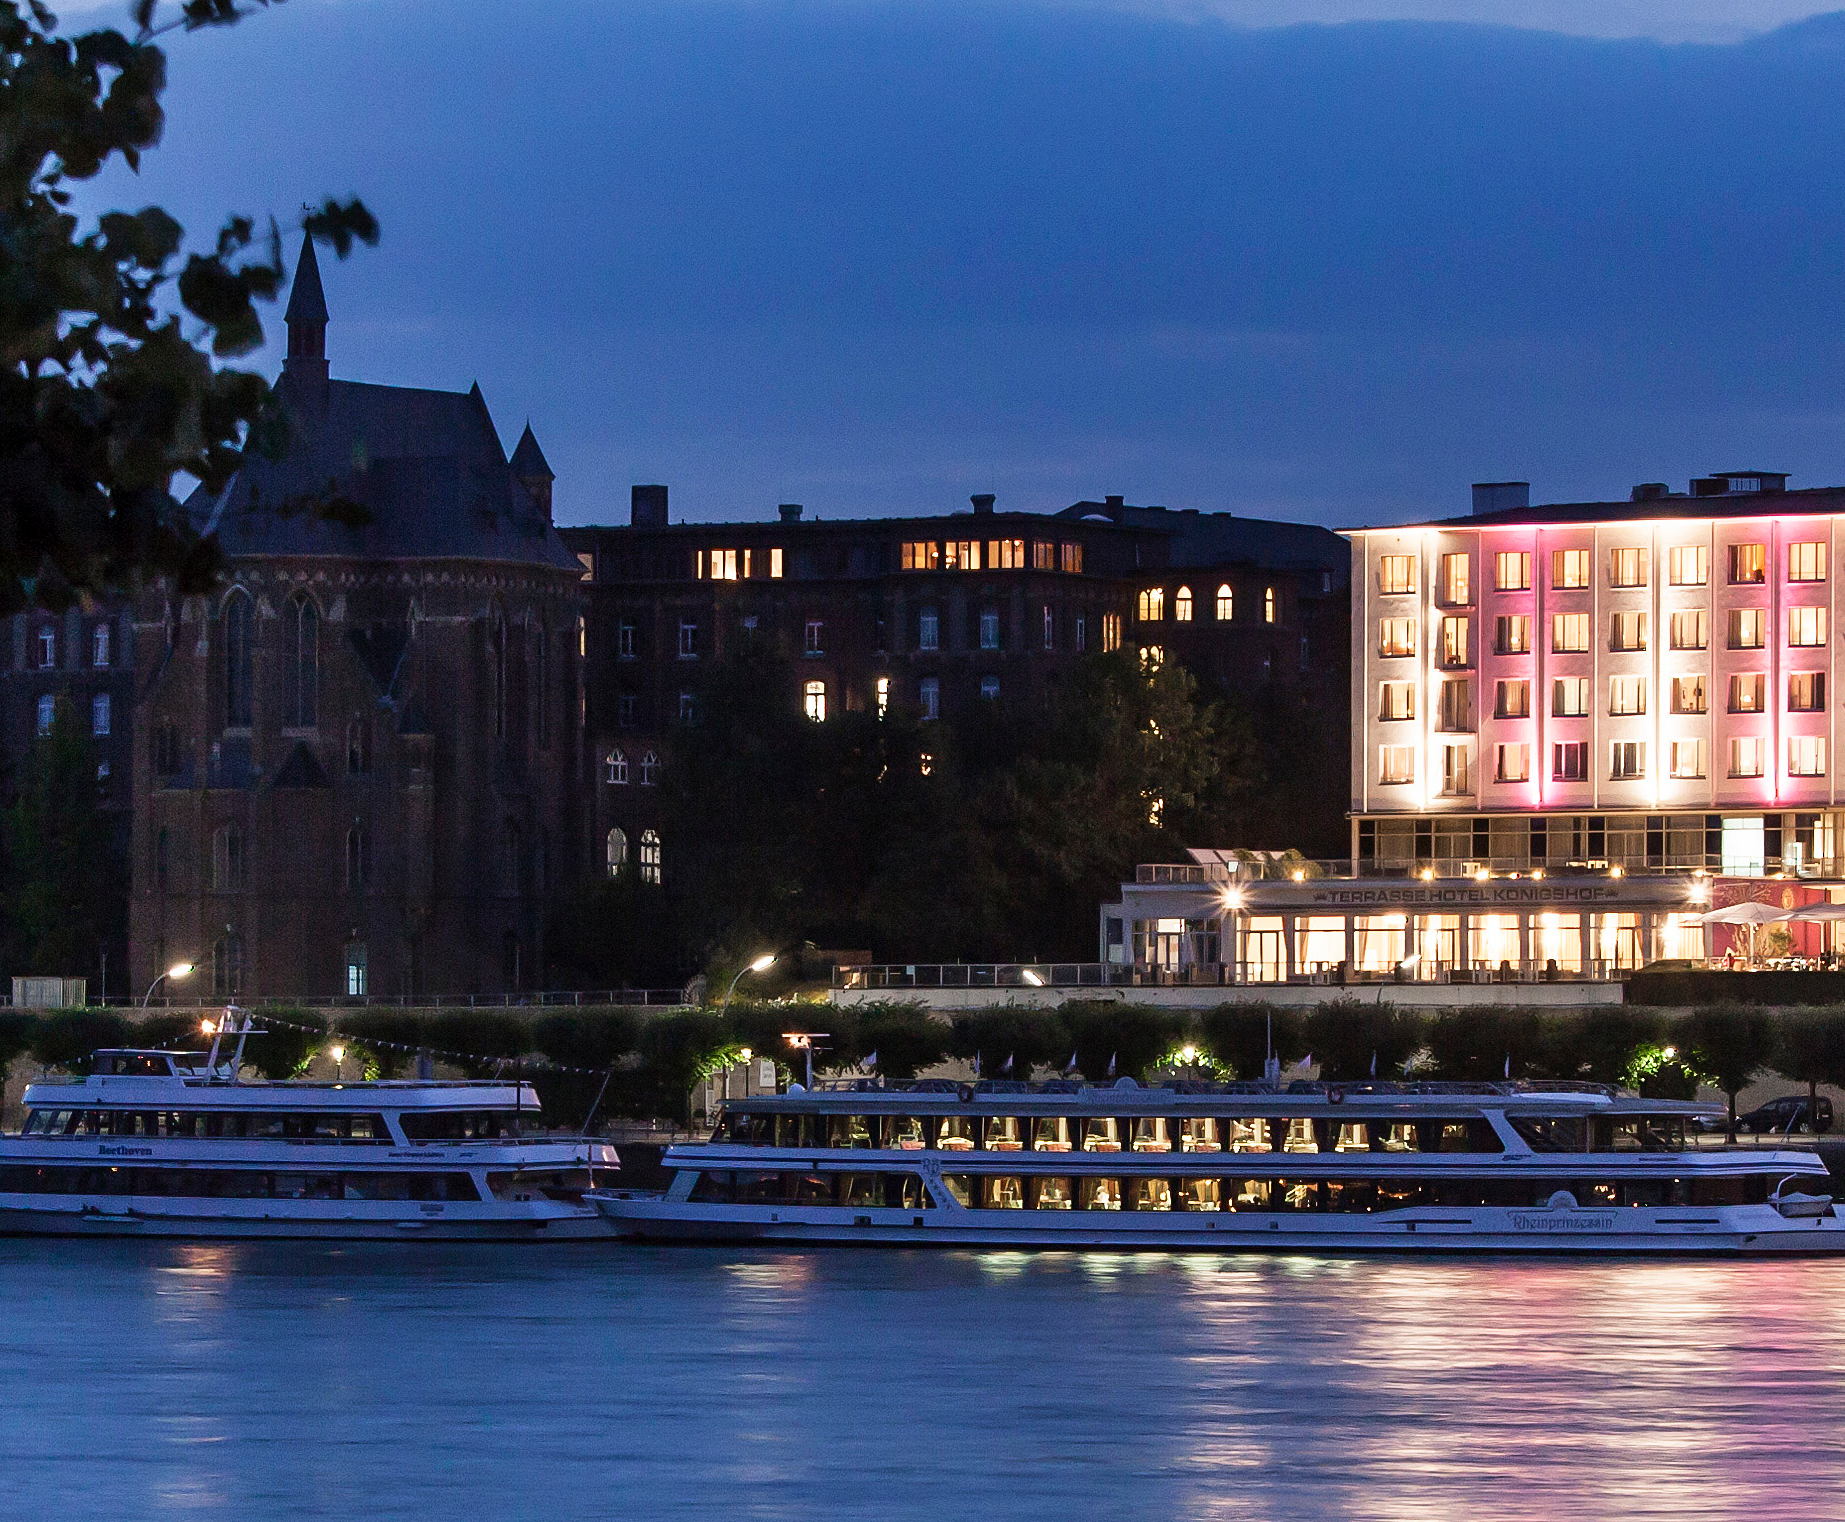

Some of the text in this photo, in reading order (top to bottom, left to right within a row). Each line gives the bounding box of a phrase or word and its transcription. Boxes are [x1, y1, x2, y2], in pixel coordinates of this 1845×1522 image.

[1330, 890, 1426, 902] TERRASSE
[1429, 889, 1489, 901] HOTEL
[98, 1144, 153, 1156] Beethoven
[1512, 1215, 1613, 1230] Rheinprinzessin
